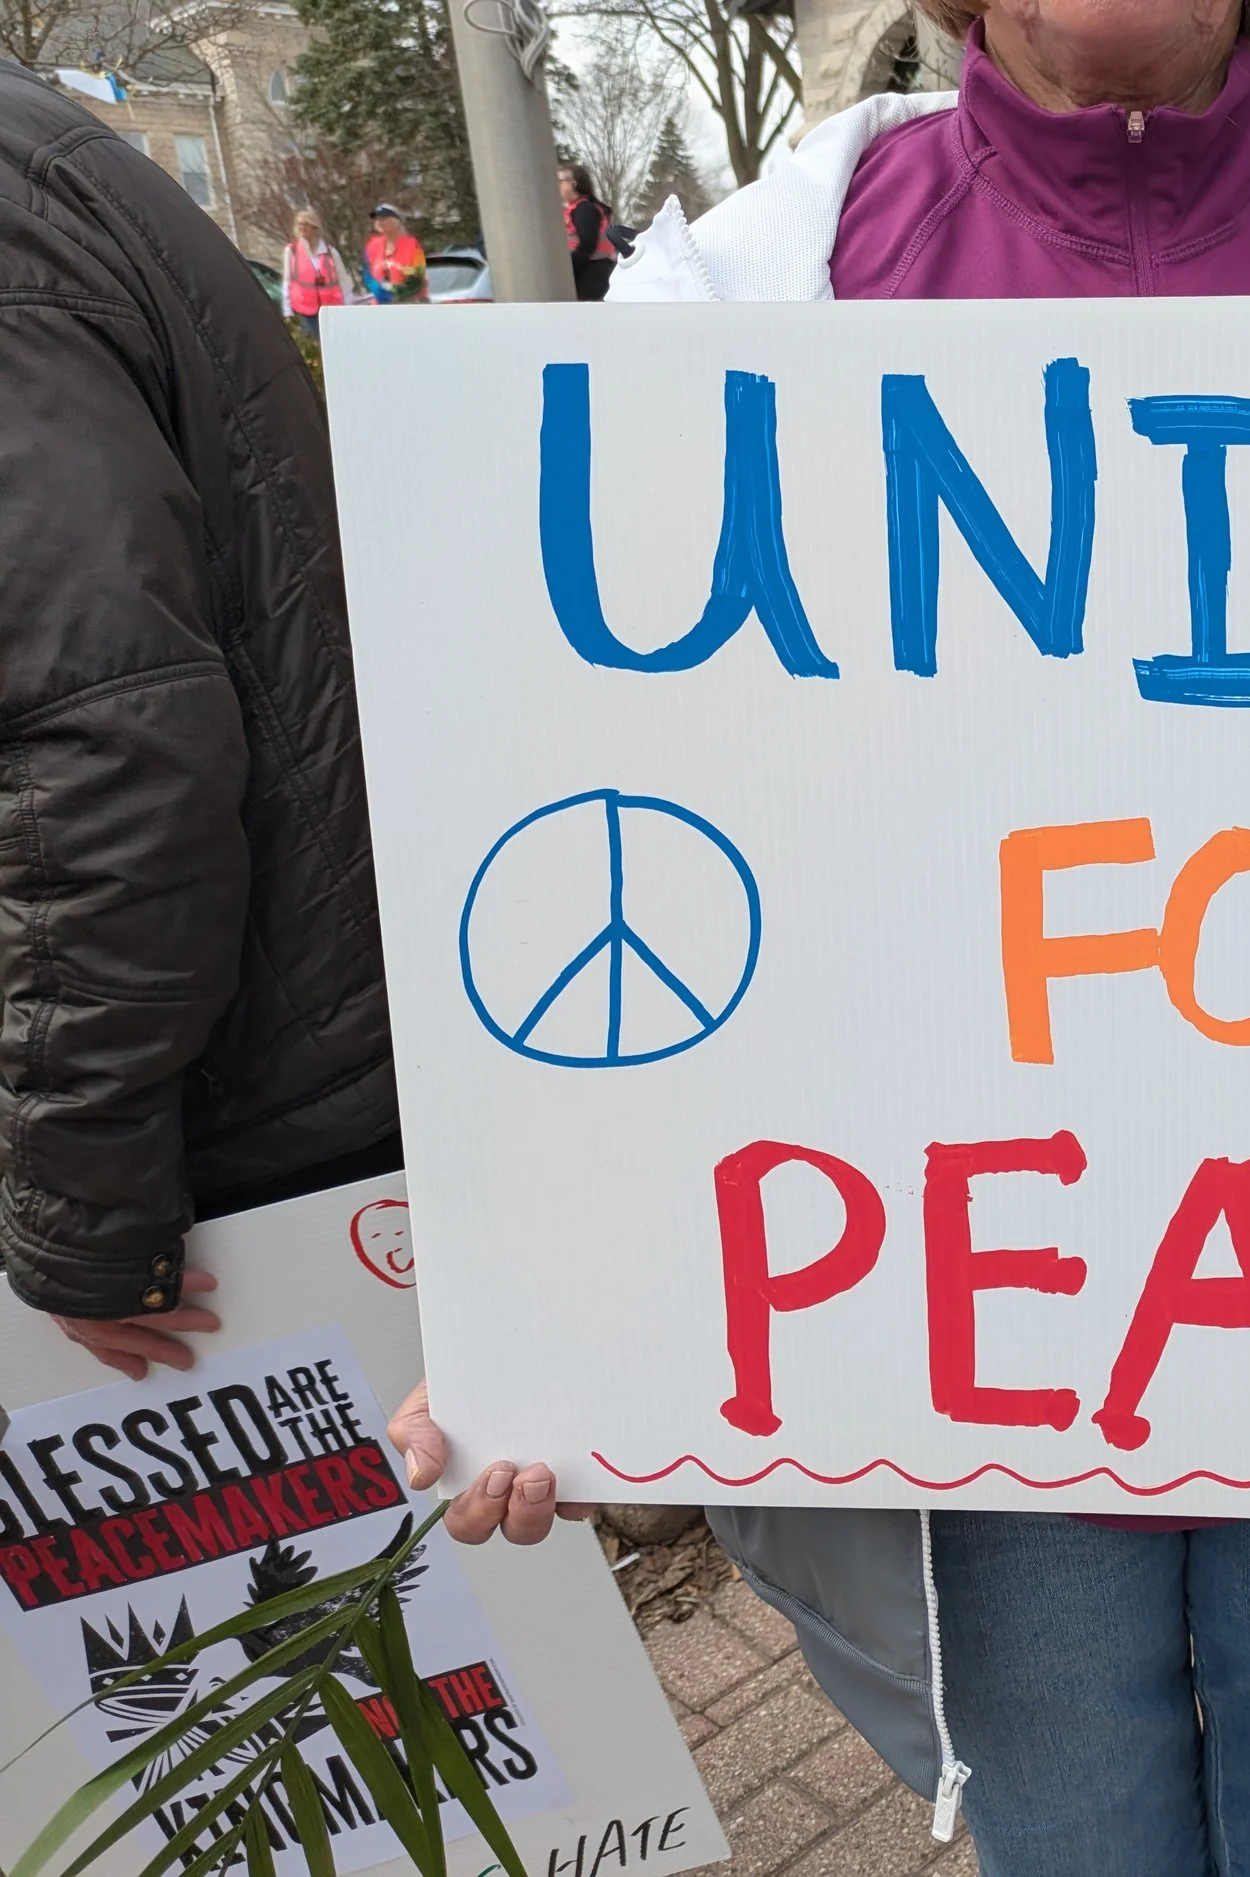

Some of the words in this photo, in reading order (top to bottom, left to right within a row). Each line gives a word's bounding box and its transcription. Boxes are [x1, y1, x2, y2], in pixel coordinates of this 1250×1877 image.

[264, 1358, 351, 1419] ARE
[278, 1401, 376, 1460] THE
[0, 1446, 400, 1608] PEACEMAKERS
[427, 1665, 504, 1720] THE
[547, 1806, 691, 1877] HATE
